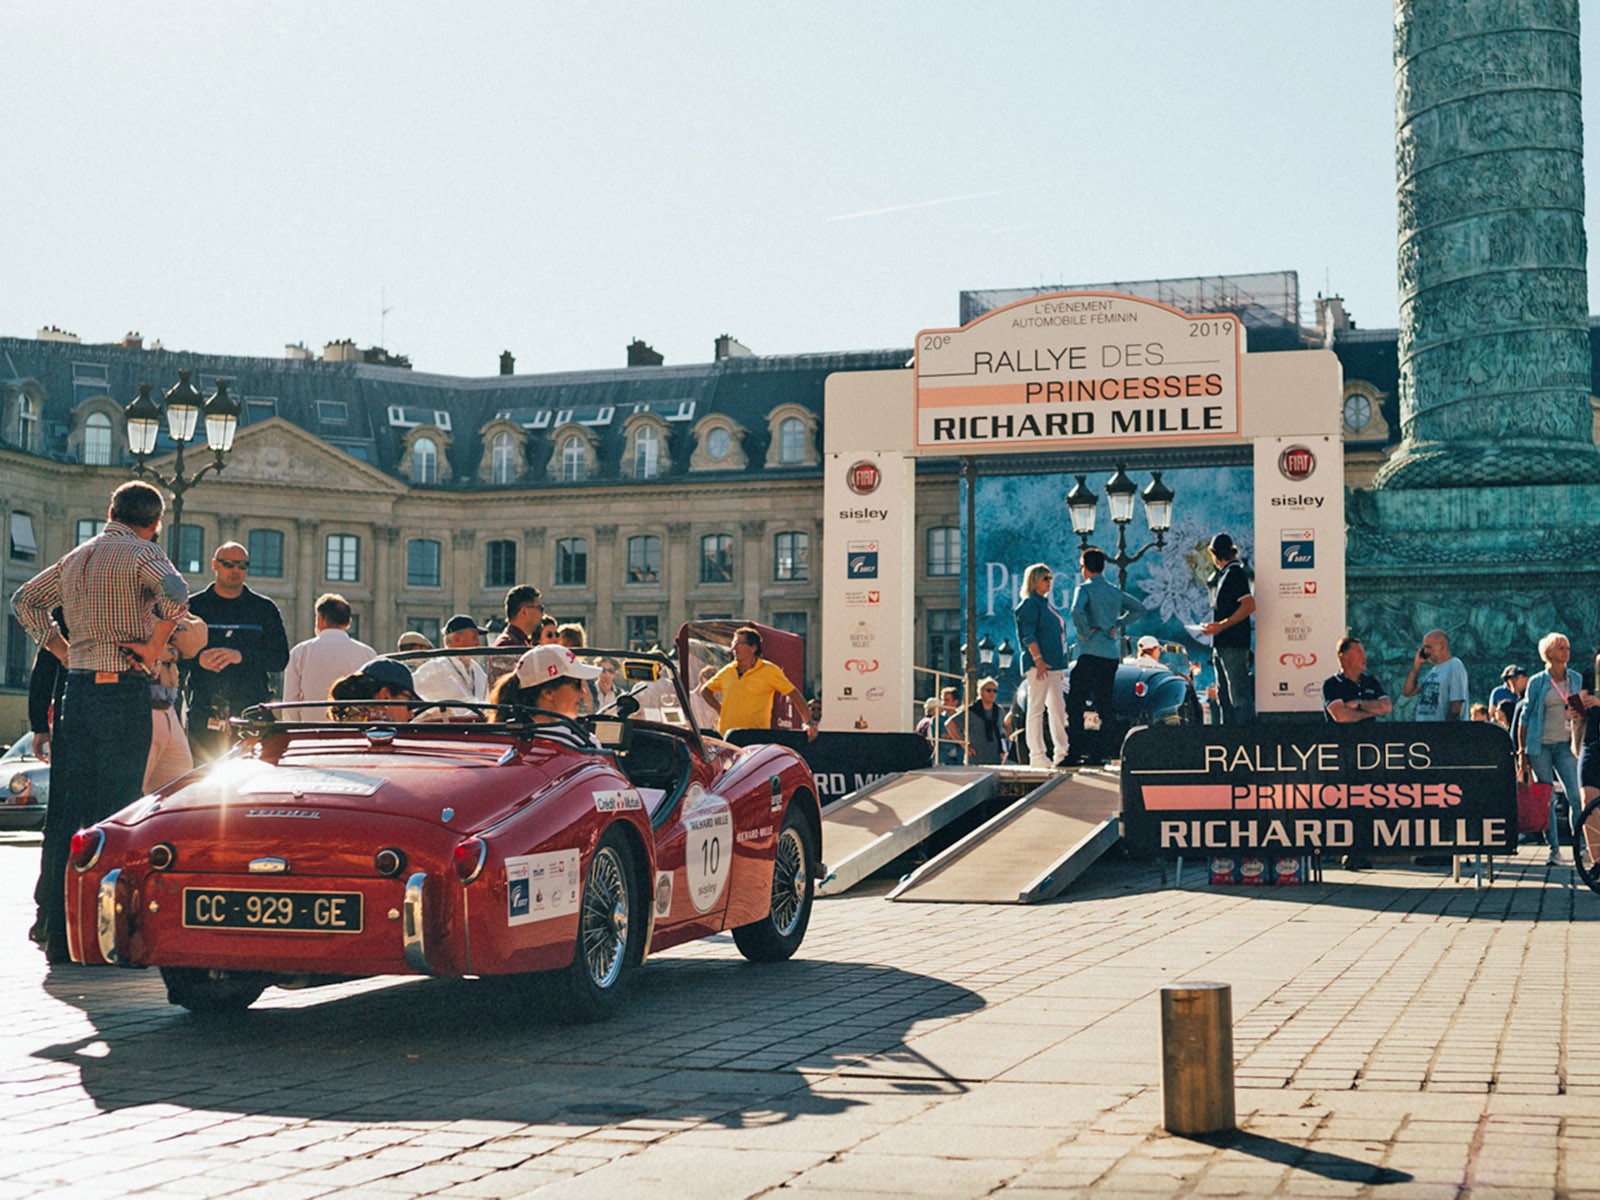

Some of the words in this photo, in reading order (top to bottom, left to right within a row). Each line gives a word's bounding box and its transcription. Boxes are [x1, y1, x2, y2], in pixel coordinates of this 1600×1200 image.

[1012, 315, 1087, 328] AUTOMOBILE
[1090, 312, 1138, 324] FÉMININ
[1035, 300, 1114, 315] L'ÉVÉNEMENT
[1189, 321, 1233, 337] 2019
[974, 347, 1087, 374] RALLYE
[1102, 342, 1164, 368] DES
[1026, 373, 1223, 404] PRINCESSES
[934, 411, 1095, 441] RICHARD
[1111, 406, 1223, 433] MILLE
[1288, 455, 1309, 471] FIAT
[856, 469, 875, 486] FIAT
[839, 508, 888, 520] sisley
[1271, 495, 1325, 508] sisley
[1205, 744, 1339, 772] RALLYE
[1357, 742, 1431, 770] DES
[1231, 784, 1463, 810] PRINCESSES
[1160, 819, 1354, 848] RICHARD
[1373, 818, 1507, 846] MILLE
[702, 836, 720, 877] 10
[196, 895, 226, 922] CC
[246, 896, 293, 924] 929
[314, 898, 346, 926] GE
